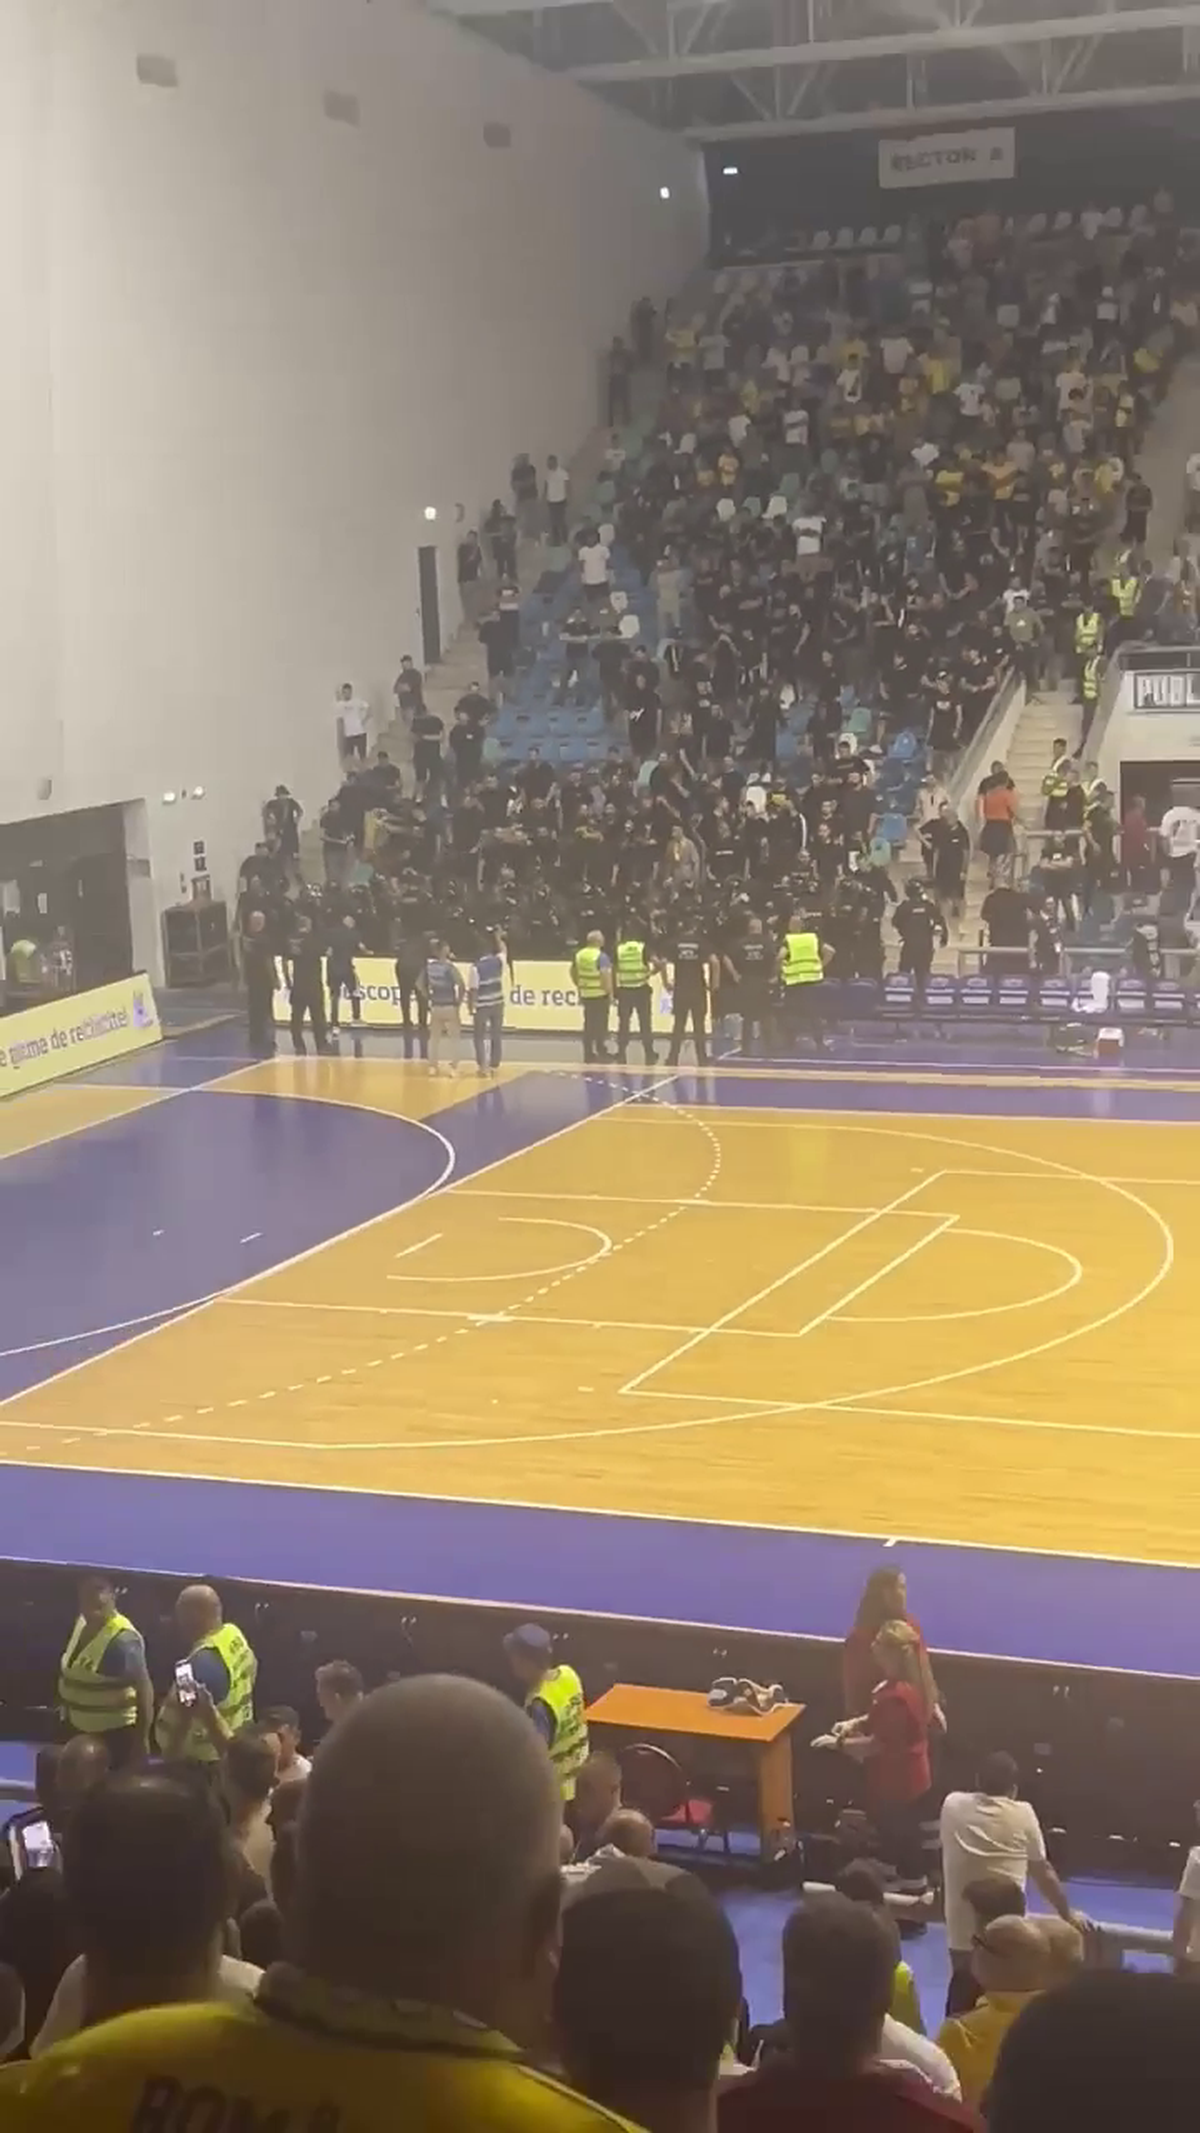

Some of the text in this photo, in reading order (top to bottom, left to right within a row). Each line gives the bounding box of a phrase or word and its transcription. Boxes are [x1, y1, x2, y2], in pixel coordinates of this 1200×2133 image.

[509, 984, 535, 1006] de
[541, 988, 579, 1006] rec
[51, 1026, 68, 1050] de
